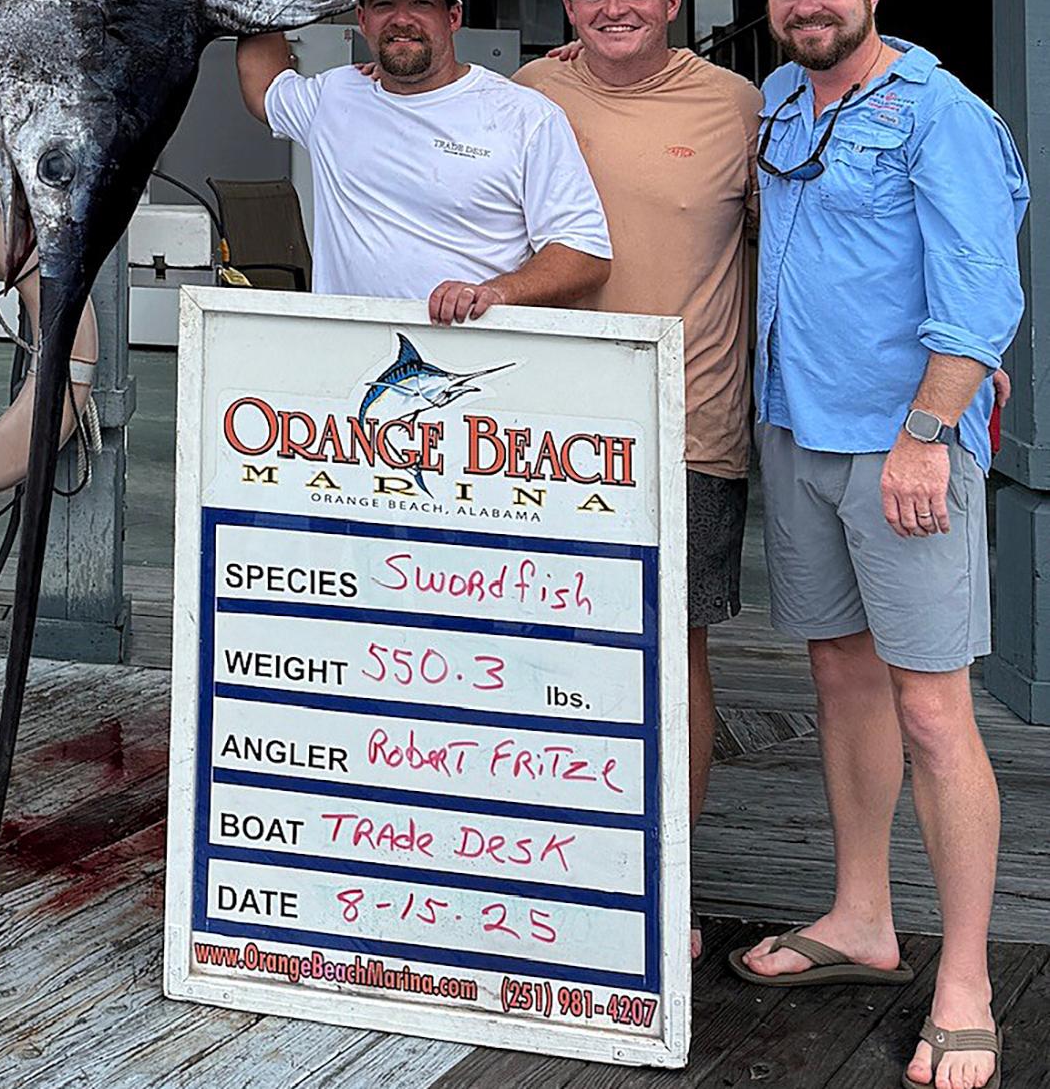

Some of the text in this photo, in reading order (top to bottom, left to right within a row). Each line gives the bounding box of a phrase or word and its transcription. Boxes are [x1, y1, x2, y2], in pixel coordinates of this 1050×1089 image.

[434, 139, 464, 151] TRADE
[465, 145, 491, 157] DESK
[223, 396, 637, 488] ORANGE BEACH
[241, 464, 616, 513] MARINA
[311, 492, 541, 523] ORANGE BEACH, ALABAMA
[225, 563, 358, 597] SPECIES
[224, 649, 348, 685] WEIGHT
[361, 641, 506, 690] 550.3
[546, 686, 591, 710] lbs.
[220, 734, 348, 772] ANGLER
[220, 813, 304, 845] BOAT
[217, 885, 298, 919] DATE
[194, 940, 658, 1028] www.OrangeBeachMarina.com (251) 981-4207
